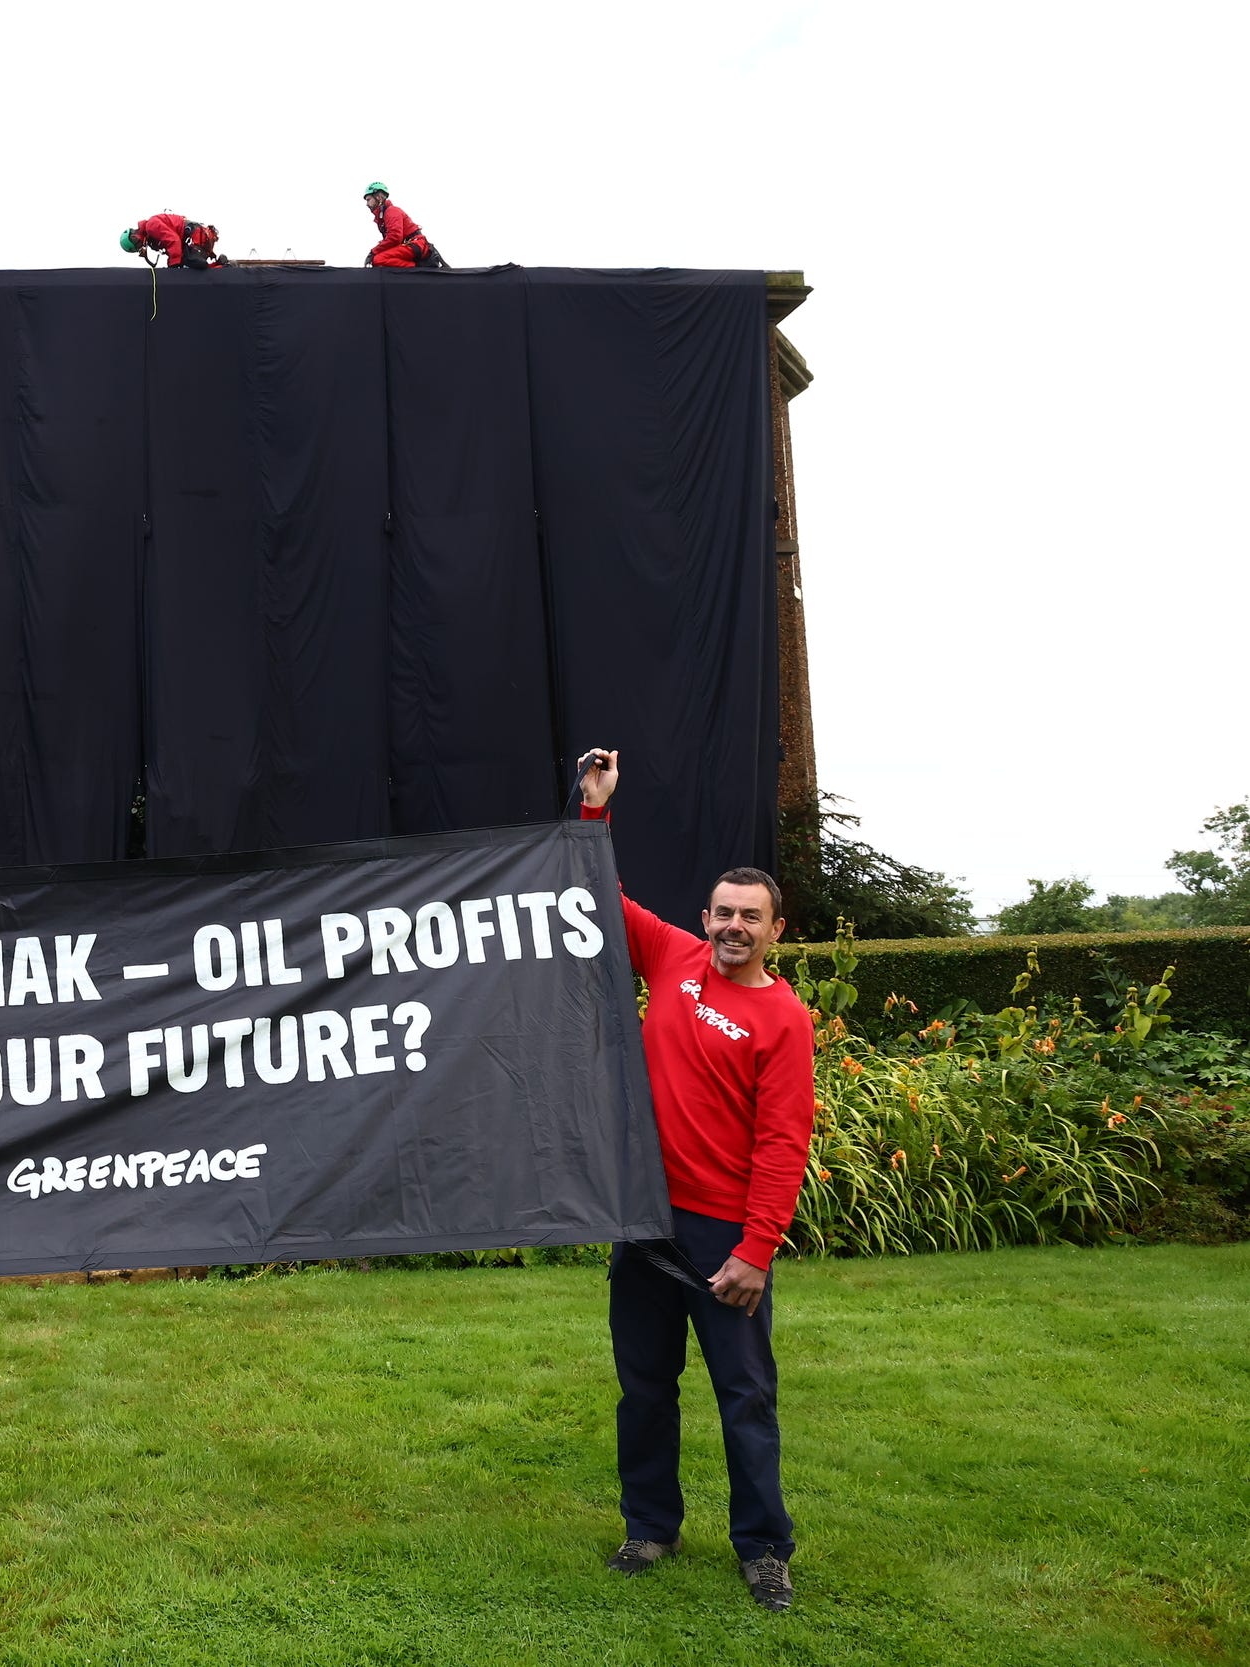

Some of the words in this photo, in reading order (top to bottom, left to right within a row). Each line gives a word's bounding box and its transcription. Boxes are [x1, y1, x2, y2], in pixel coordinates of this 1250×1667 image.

[193, 918, 303, 992] OIL
[320, 886, 604, 979] PROFITS
[127, 1000, 432, 1097] FUTURE?
[679, 979, 750, 1041] GRNPEACE
[6, 1143, 268, 1200] GREENPEACE
